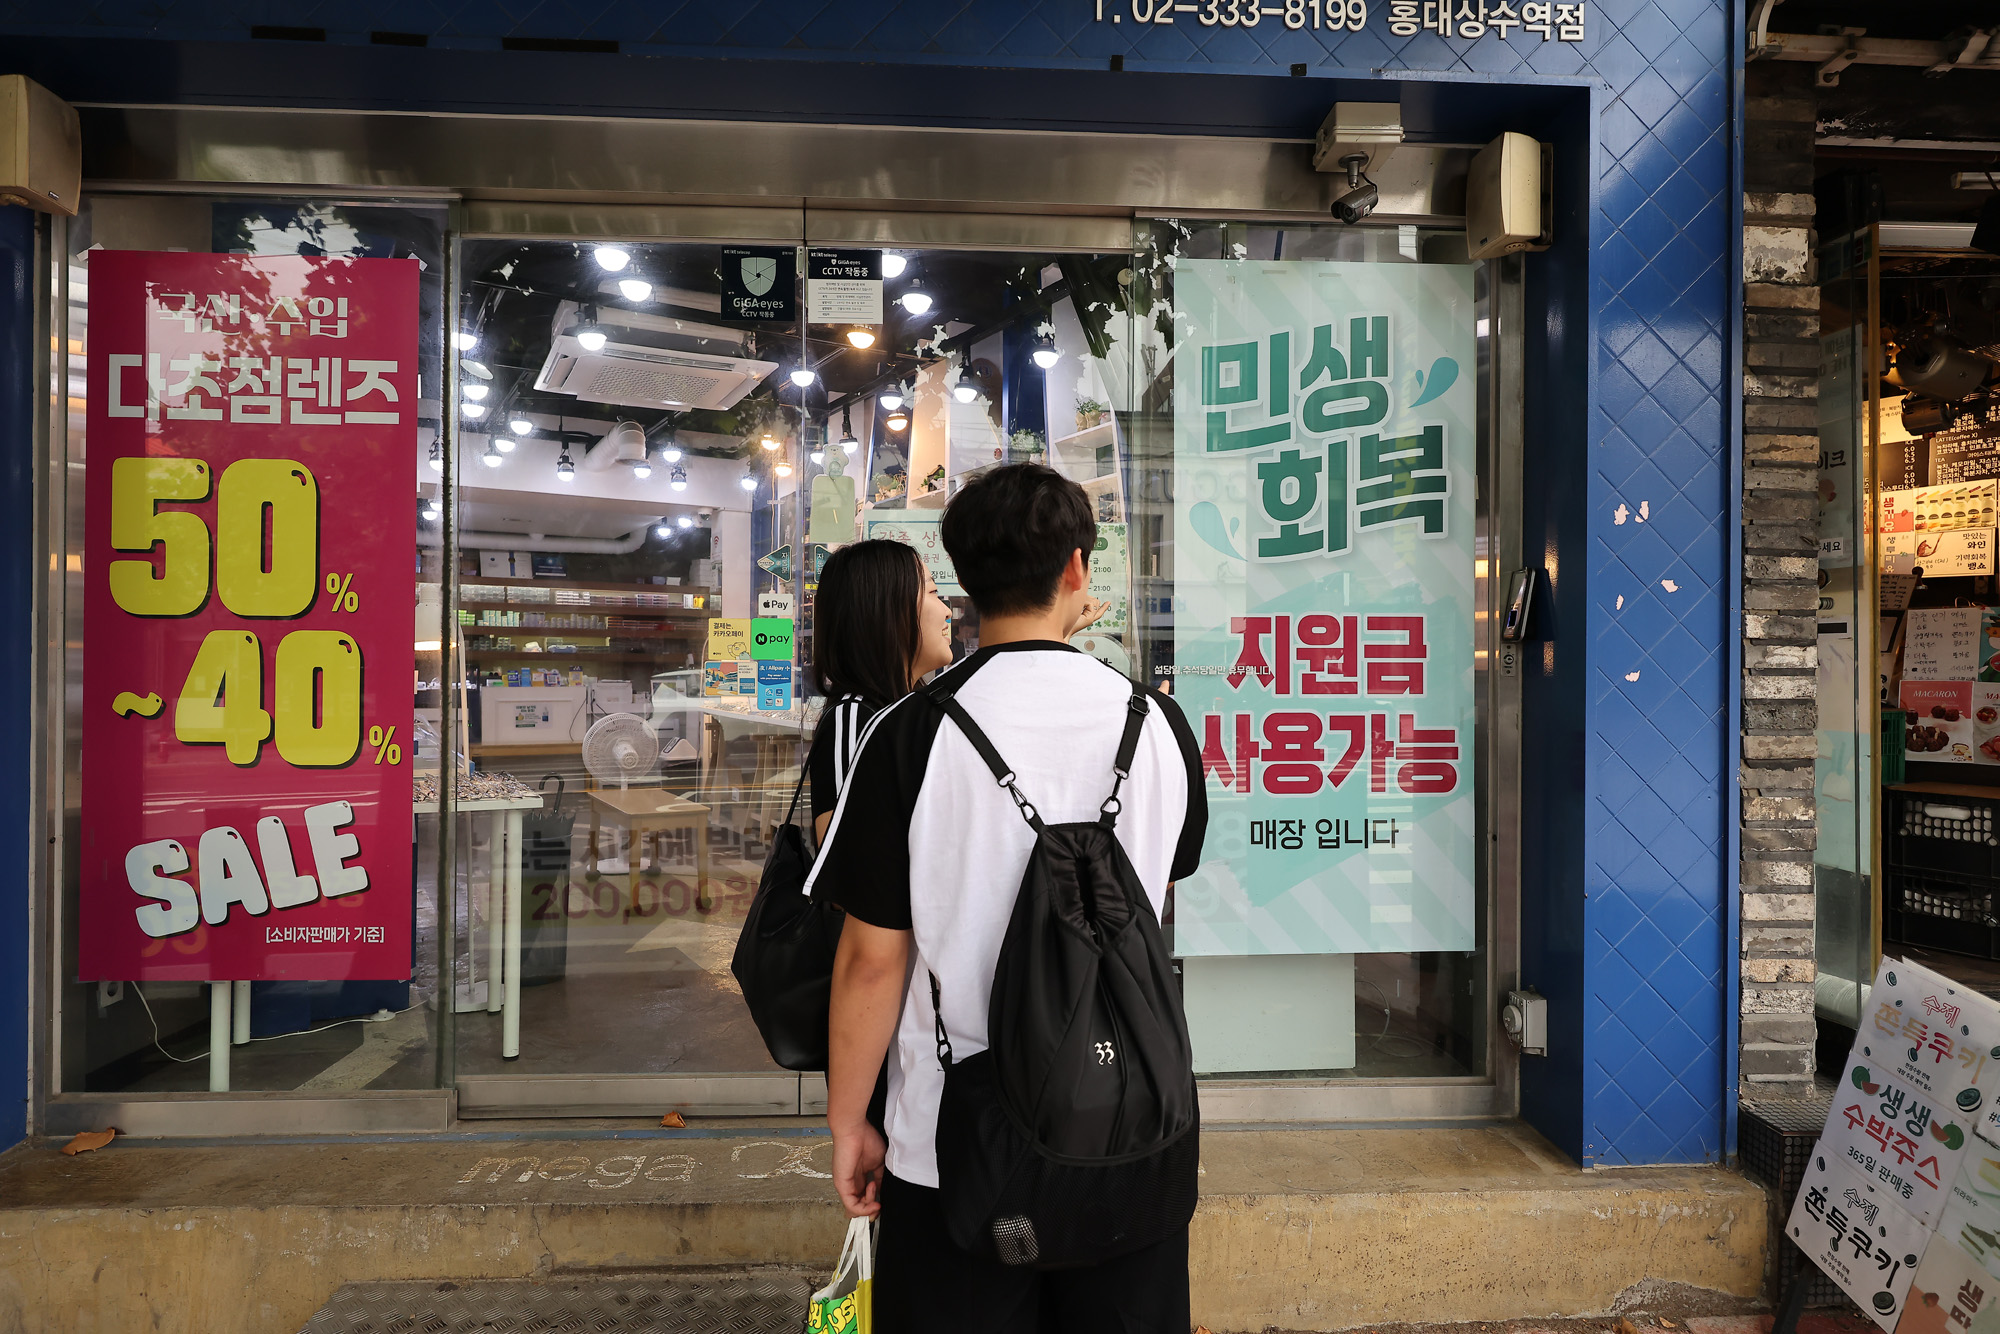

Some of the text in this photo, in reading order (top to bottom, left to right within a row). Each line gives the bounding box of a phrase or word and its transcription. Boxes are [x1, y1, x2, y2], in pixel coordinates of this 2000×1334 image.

[1131, 0, 1367, 32] 02-333-8199
[1387, 0, 1585, 42] 홍대상수역점
[822, 267, 869, 277] CCTV 작동중
[741, 310, 758, 318] CCTV
[760, 299, 784, 310] eyes
[107, 352, 400, 426] 다초점렌즈
[1199, 314, 1390, 454] 민생
[1256, 424, 1448, 558] 회복
[771, 600, 789, 610] Pay
[769, 634, 790, 644] pay
[1225, 613, 1428, 695] 지원금
[1913, 690, 1958, 698] MACARON
[1200, 711, 1460, 795] 사용가능
[1250, 818, 1400, 850] 매장 입니다
[124, 800, 370, 939] SALE
[265, 926, 385, 943] [소비자판매가 기준]
[1921, 995, 1961, 1028] 수제
[1873, 1002, 1987, 1085] 쫀득쿠키
[1879, 1084, 1932, 1137] 생생
[1842, 1103, 1941, 1191] 수박주스
[1847, 1145, 1915, 1200] 365일 판매중
[1842, 1188, 1880, 1226] 수제
[1804, 1185, 1901, 1289] 쫀득쿠키
